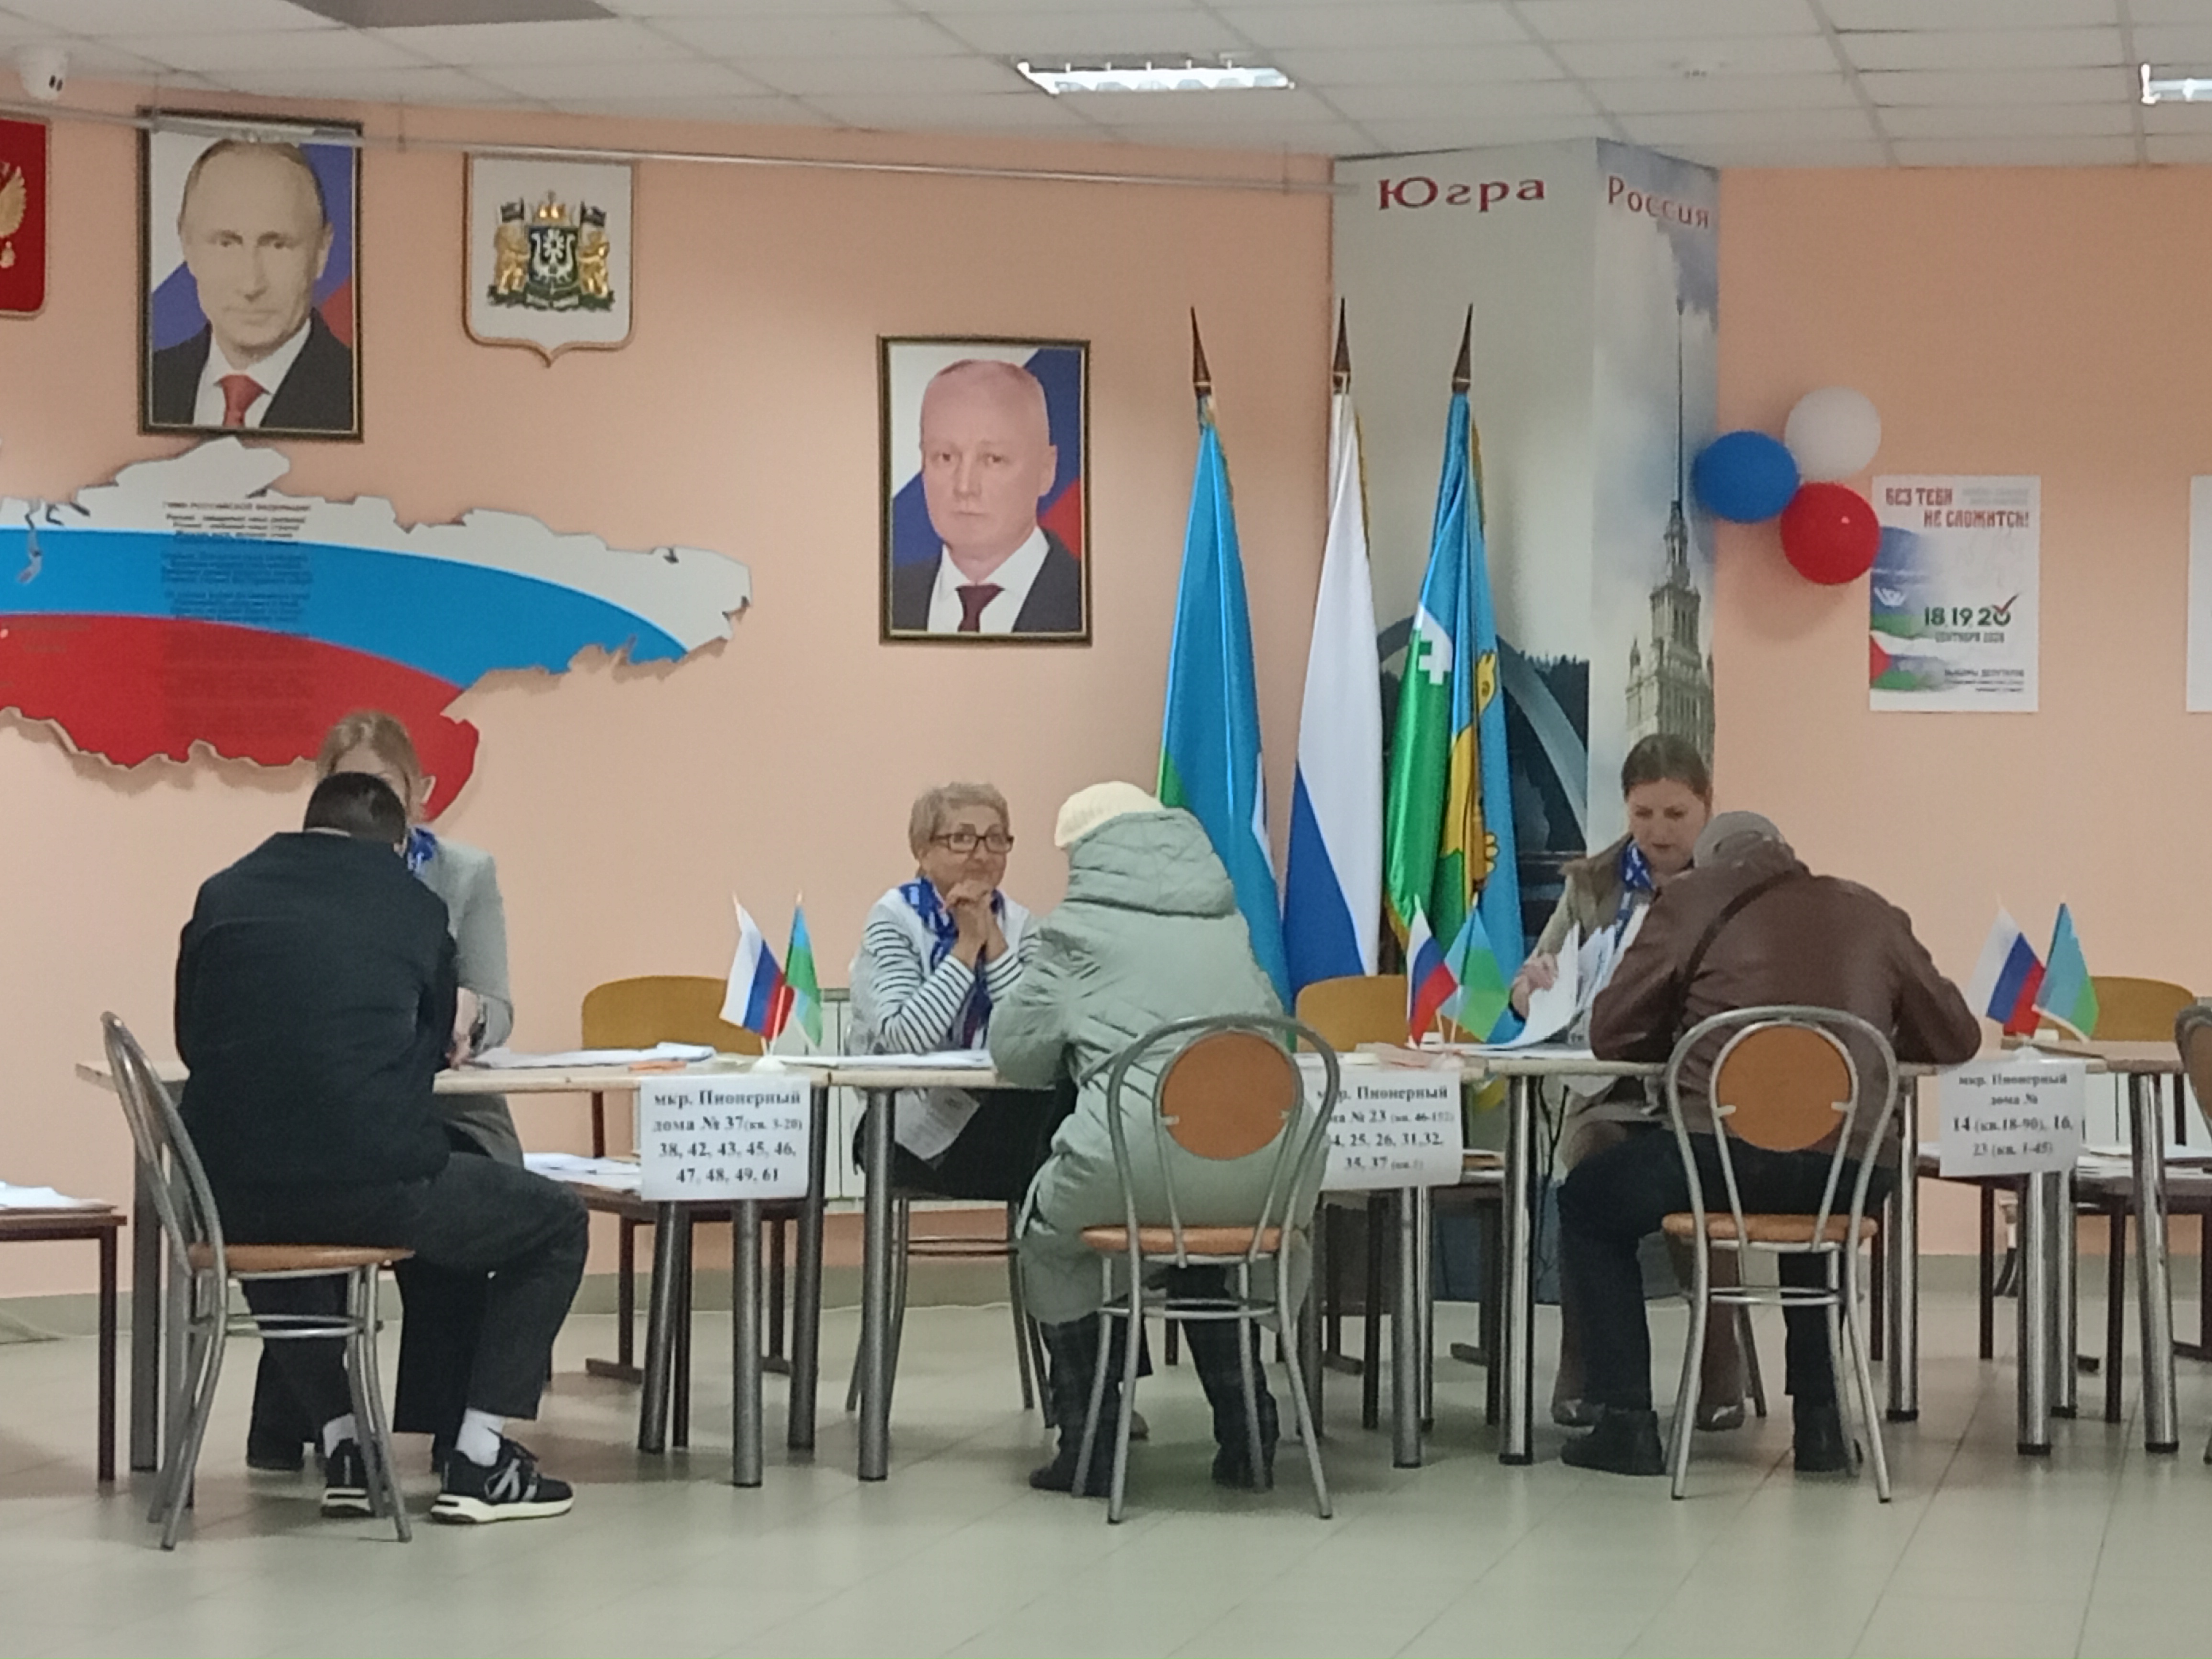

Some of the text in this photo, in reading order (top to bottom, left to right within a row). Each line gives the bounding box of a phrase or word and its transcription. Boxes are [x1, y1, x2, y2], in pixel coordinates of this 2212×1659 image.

[1378, 176, 1546, 213] Югра
[1607, 175, 1711, 229] Россия
[1886, 487, 1912, 506] БЕЗ
[1924, 509, 1942, 528] НЕ
[1959, 1073, 2068, 1088] мкр. Пионерный
[654, 1089, 801, 1110] мкр. Пионерный
[1357, 1085, 1448, 1102] Пионерный
[1350, 1110, 1365, 1123] №
[1369, 1108, 1387, 1123] 23
[653, 1119, 695, 1132] дома
[701, 1116, 720, 1131] №
[1953, 1116, 1970, 1132] 14
[1375, 1132, 1396, 1147] 26,
[658, 1142, 683, 1159] 38,
[687, 1141, 712, 1159] 42,
[774, 1140, 796, 1158] 46,
[1973, 1141, 1988, 1157] 23
[762, 1167, 779, 1182] 61
